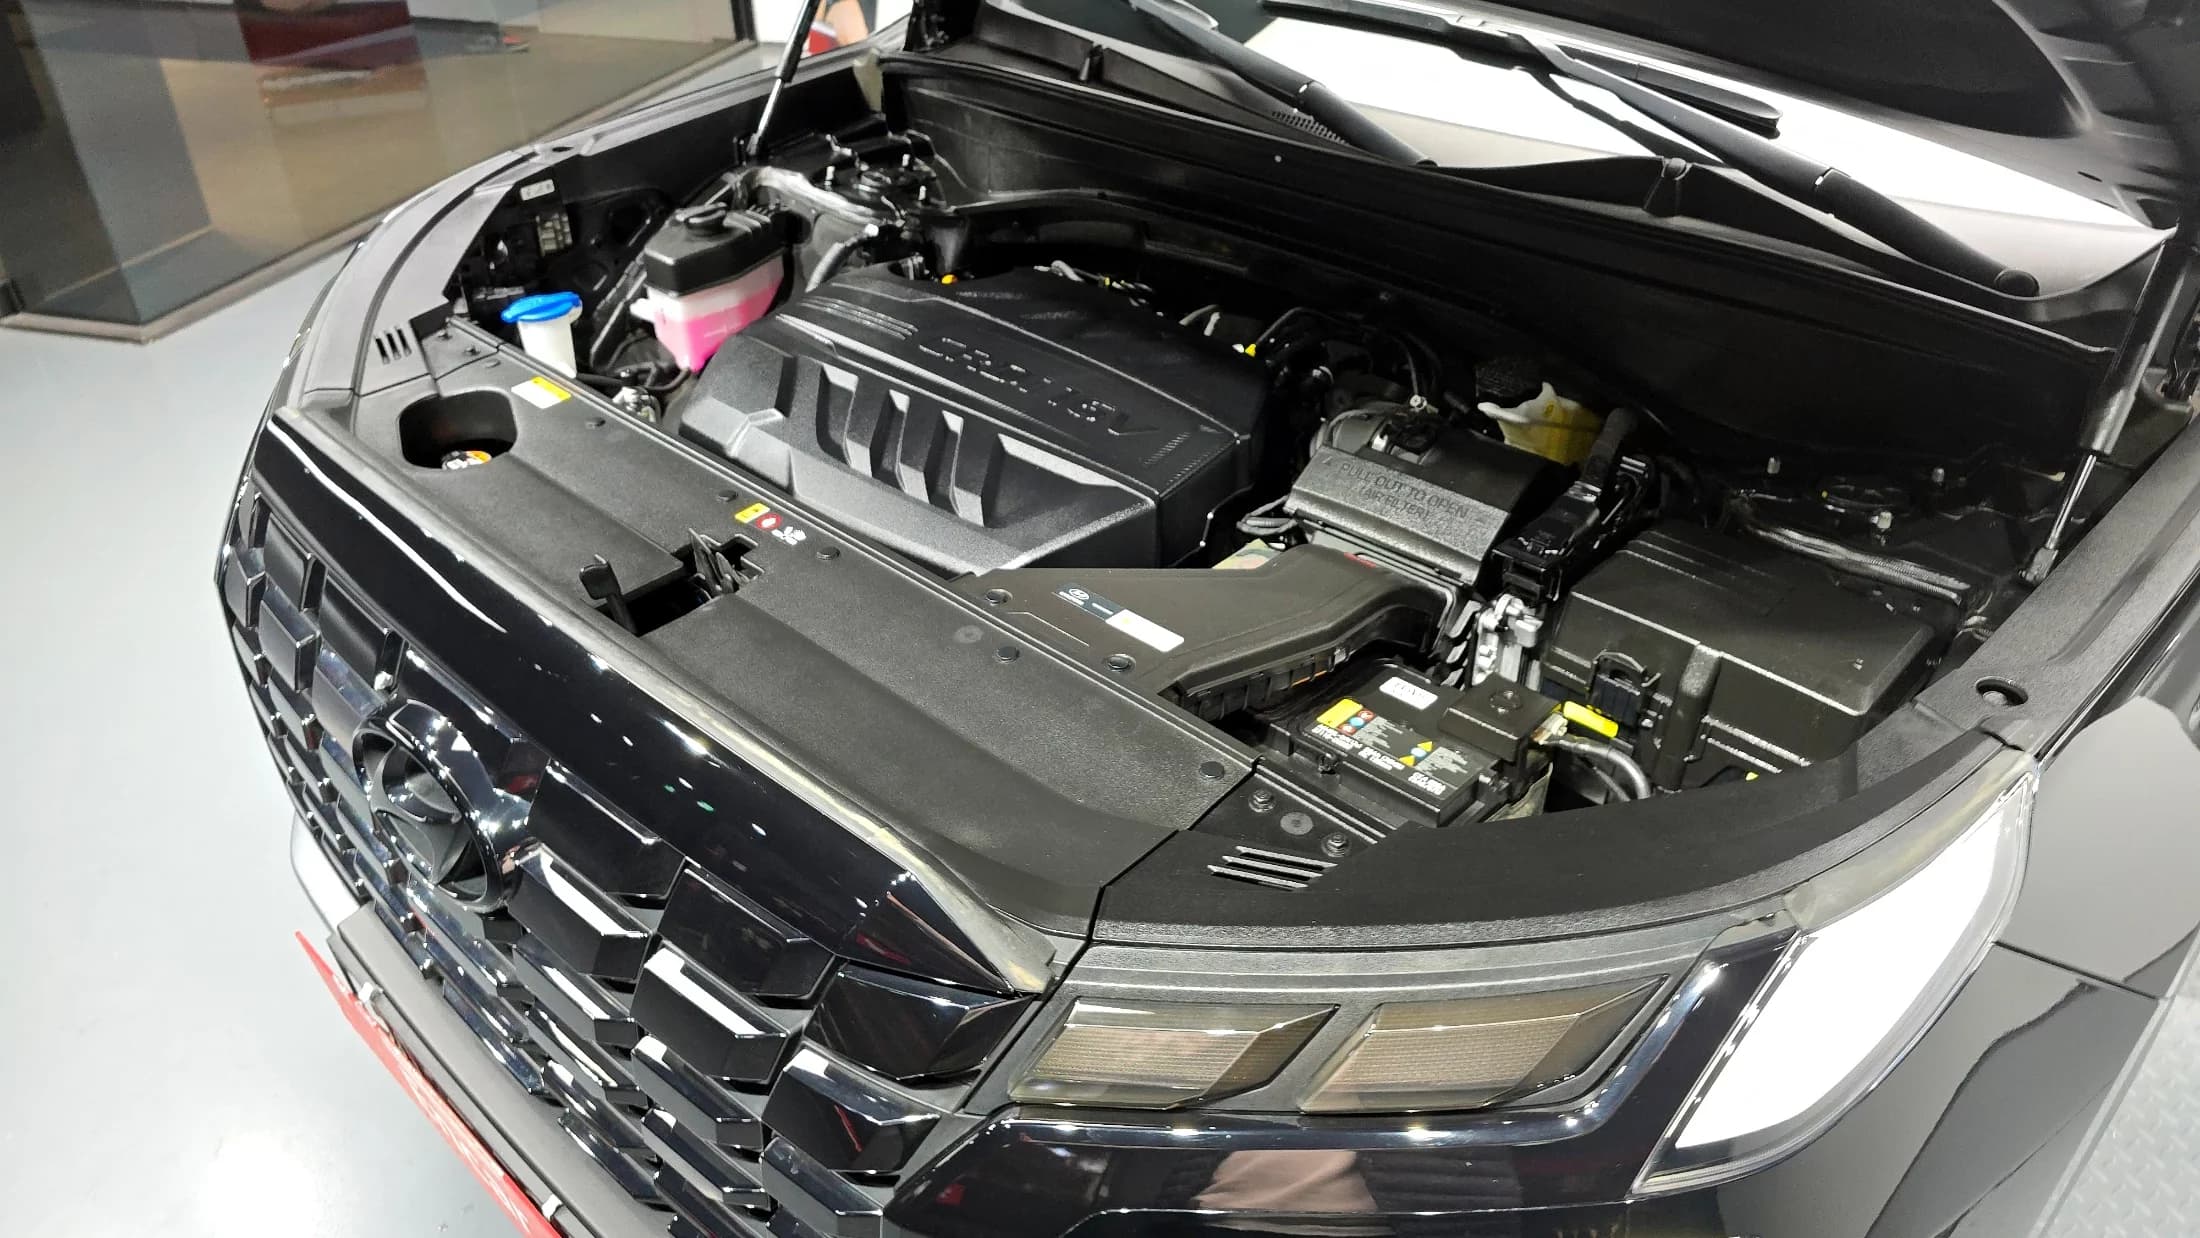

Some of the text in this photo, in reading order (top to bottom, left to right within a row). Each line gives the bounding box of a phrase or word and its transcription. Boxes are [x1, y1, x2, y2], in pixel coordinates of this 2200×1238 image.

[1341, 463, 1471, 518] PULL OUT TO OPEN
